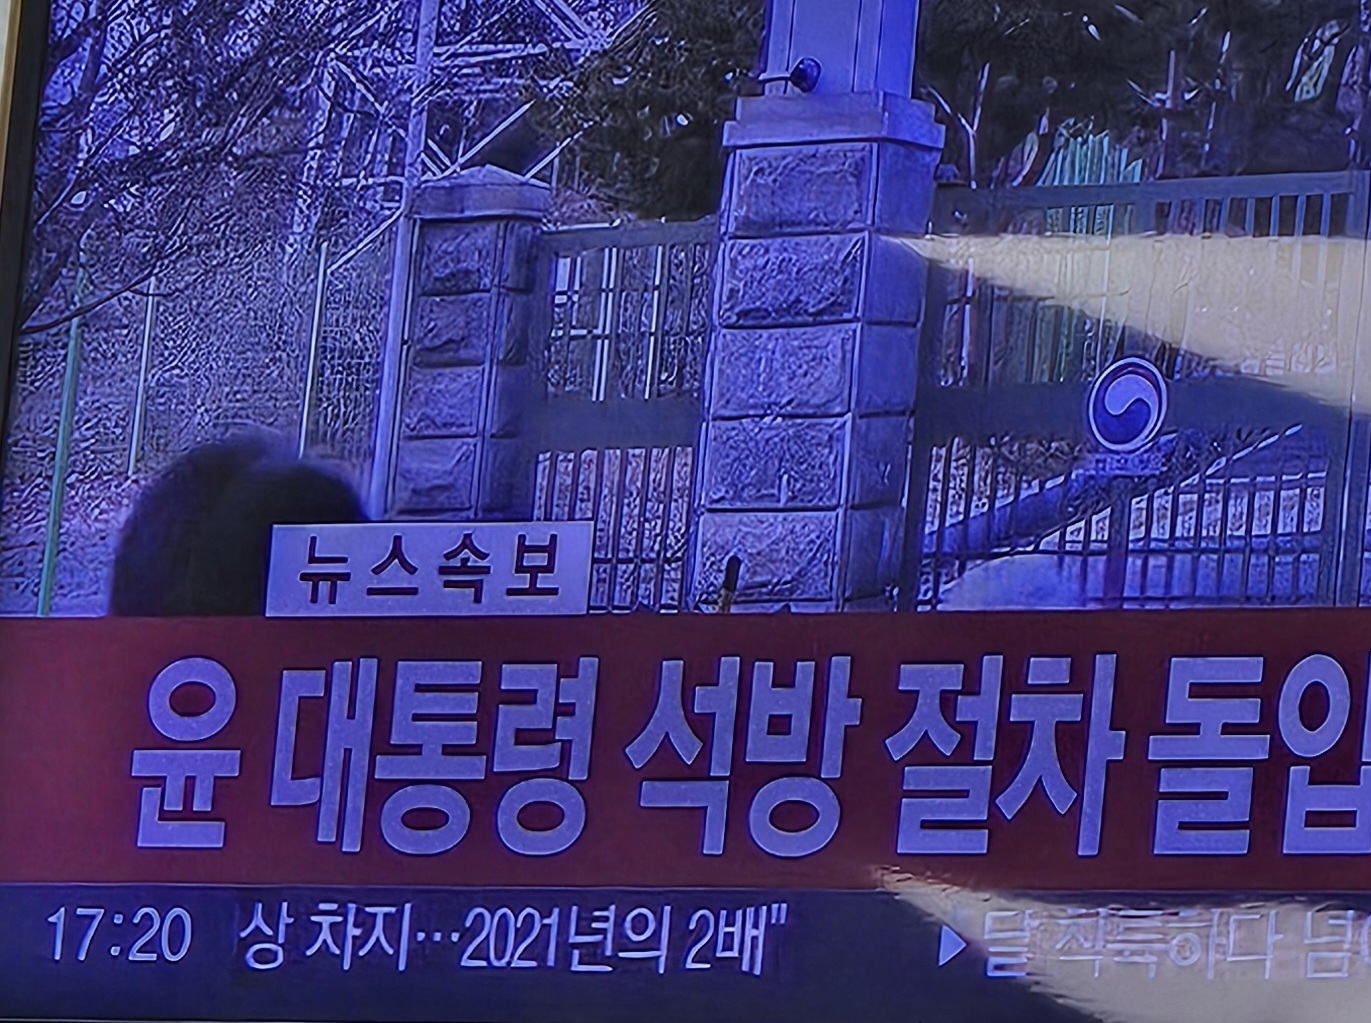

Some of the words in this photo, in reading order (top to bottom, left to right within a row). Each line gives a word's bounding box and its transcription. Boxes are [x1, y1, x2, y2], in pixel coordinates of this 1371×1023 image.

[299, 532, 560, 604] 뉴스속보
[130, 656, 241, 849] 윤
[269, 655, 600, 857] 대통령
[625, 655, 862, 858] 석방
[884, 653, 1126, 858] 절차
[46, 906, 193, 963] 17:20
[238, 901, 295, 970] 상
